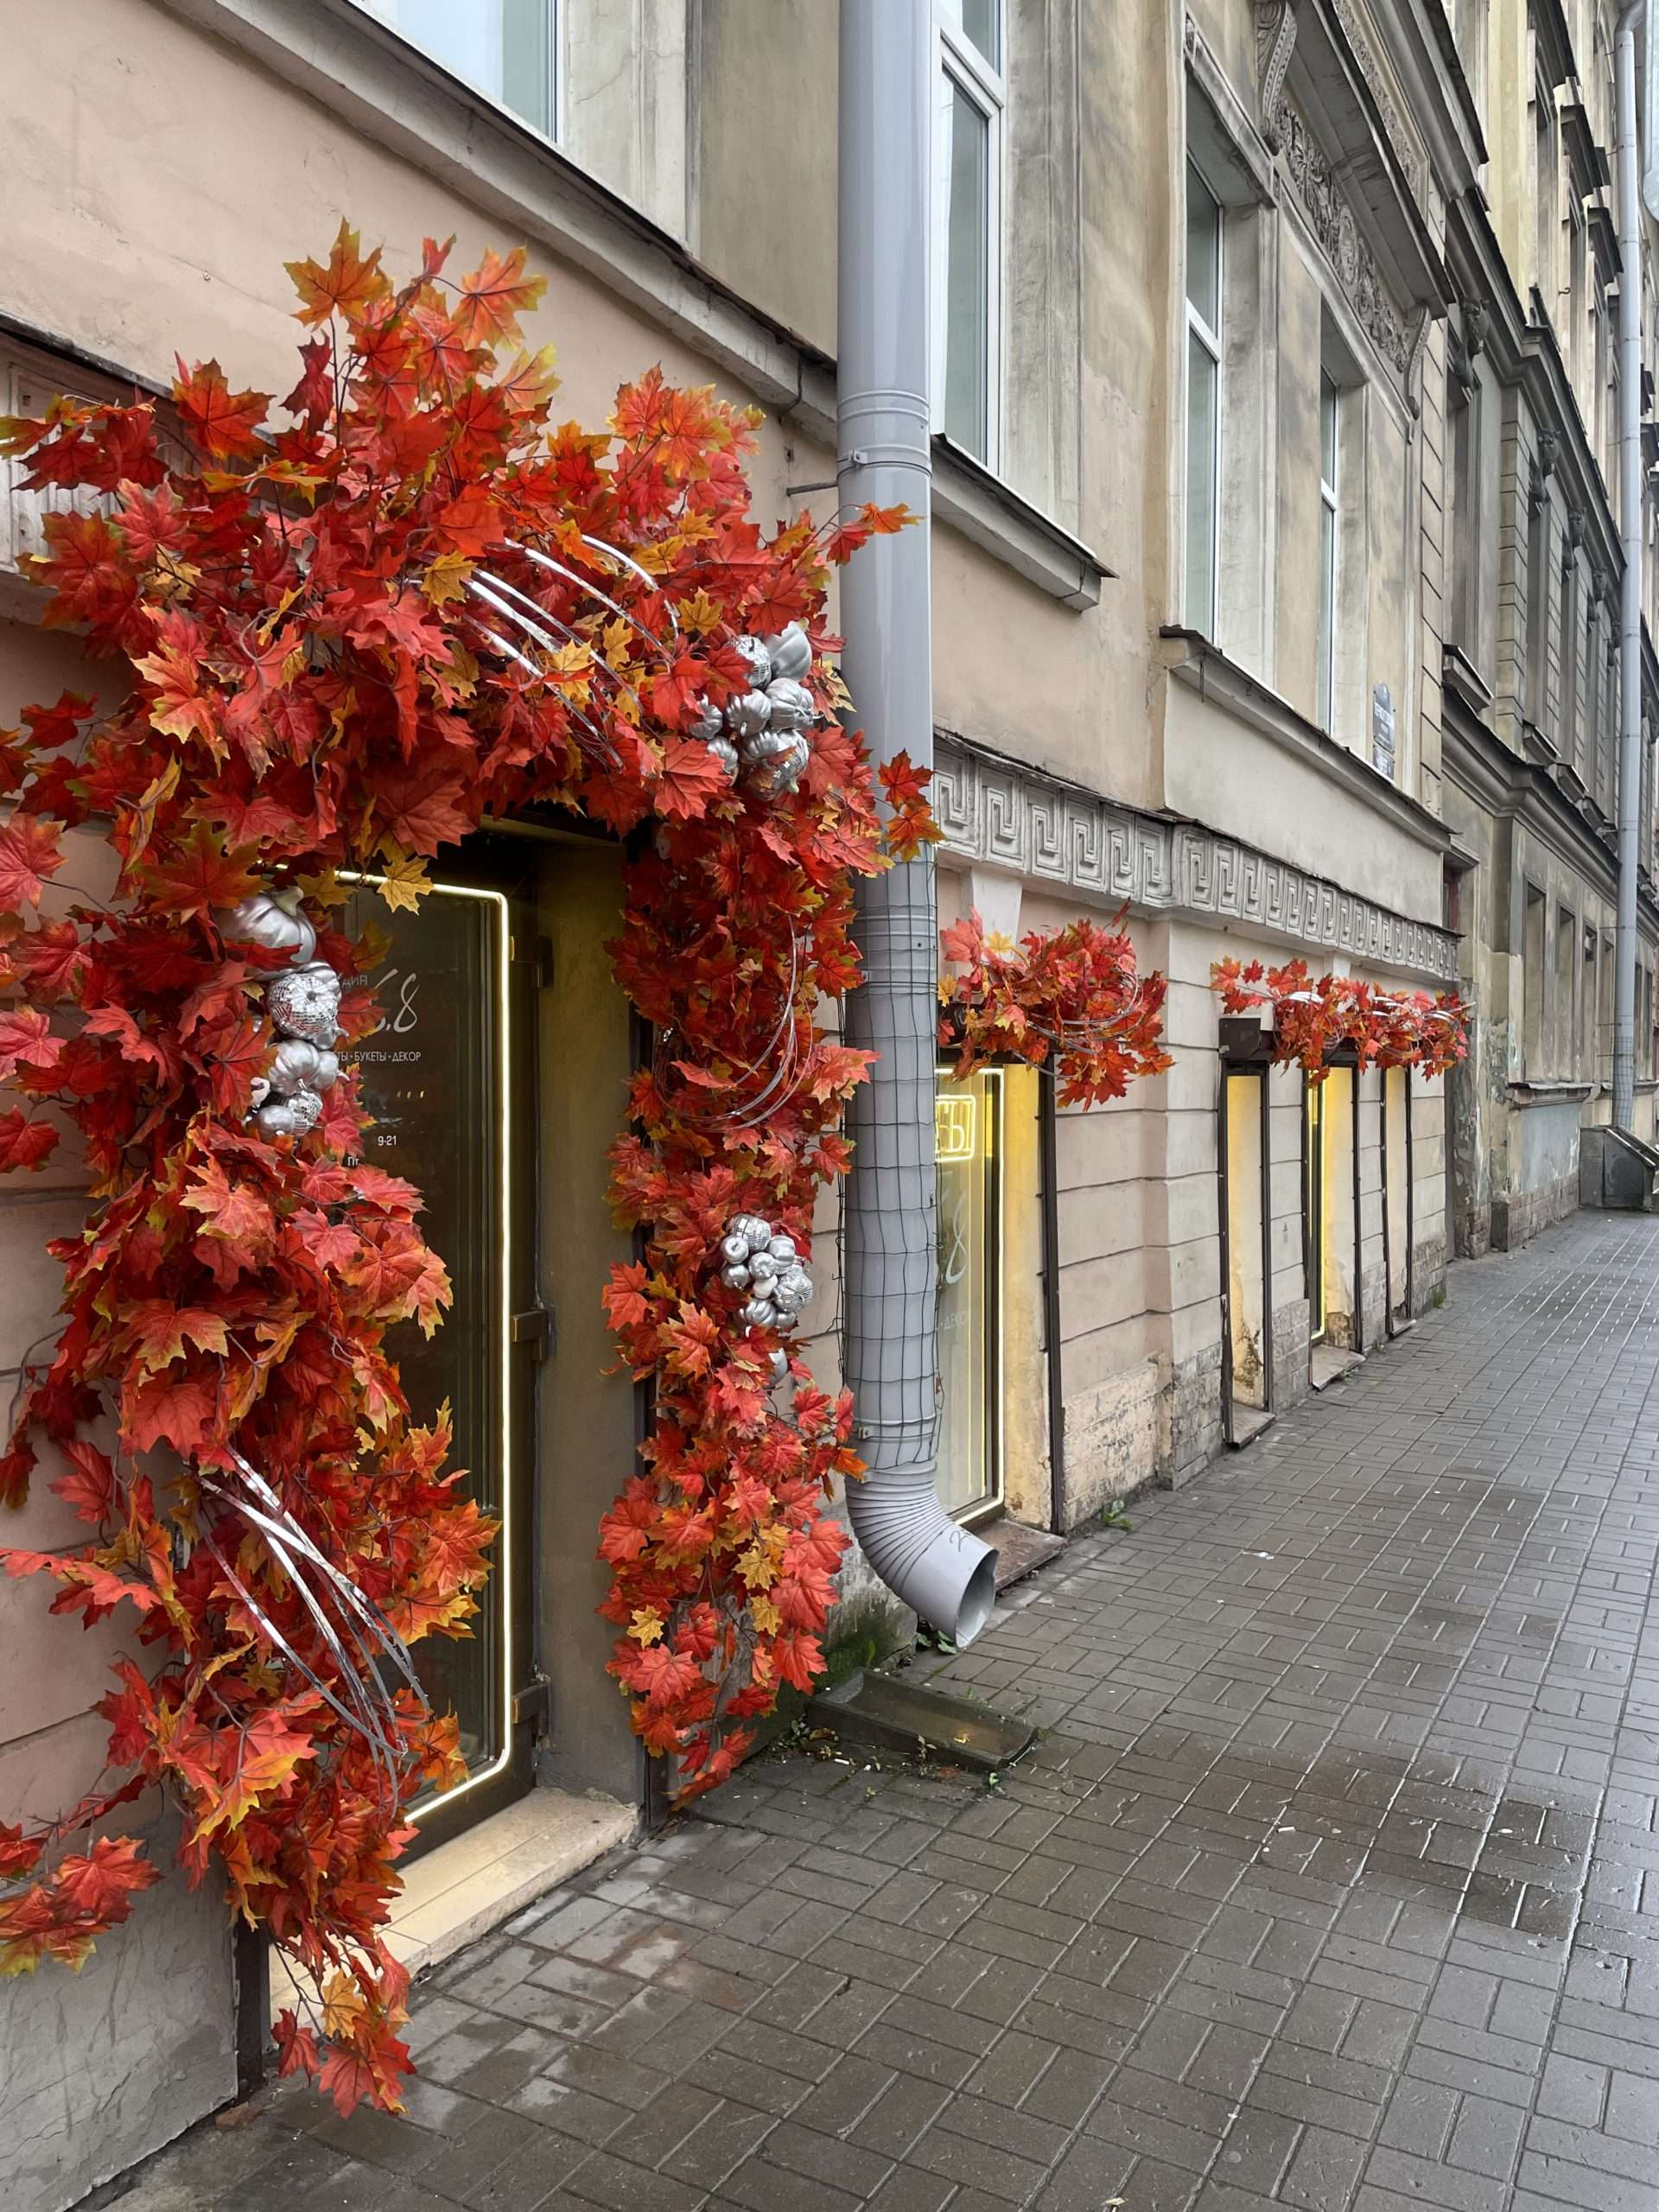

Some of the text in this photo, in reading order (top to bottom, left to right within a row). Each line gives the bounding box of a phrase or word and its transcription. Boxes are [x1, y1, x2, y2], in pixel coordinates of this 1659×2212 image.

[354, 1051, 386, 1062] БУКЕТЫ
[391, 1051, 422, 1062] ДЕКОР
[378, 1135, 397, 1147] 9-21
